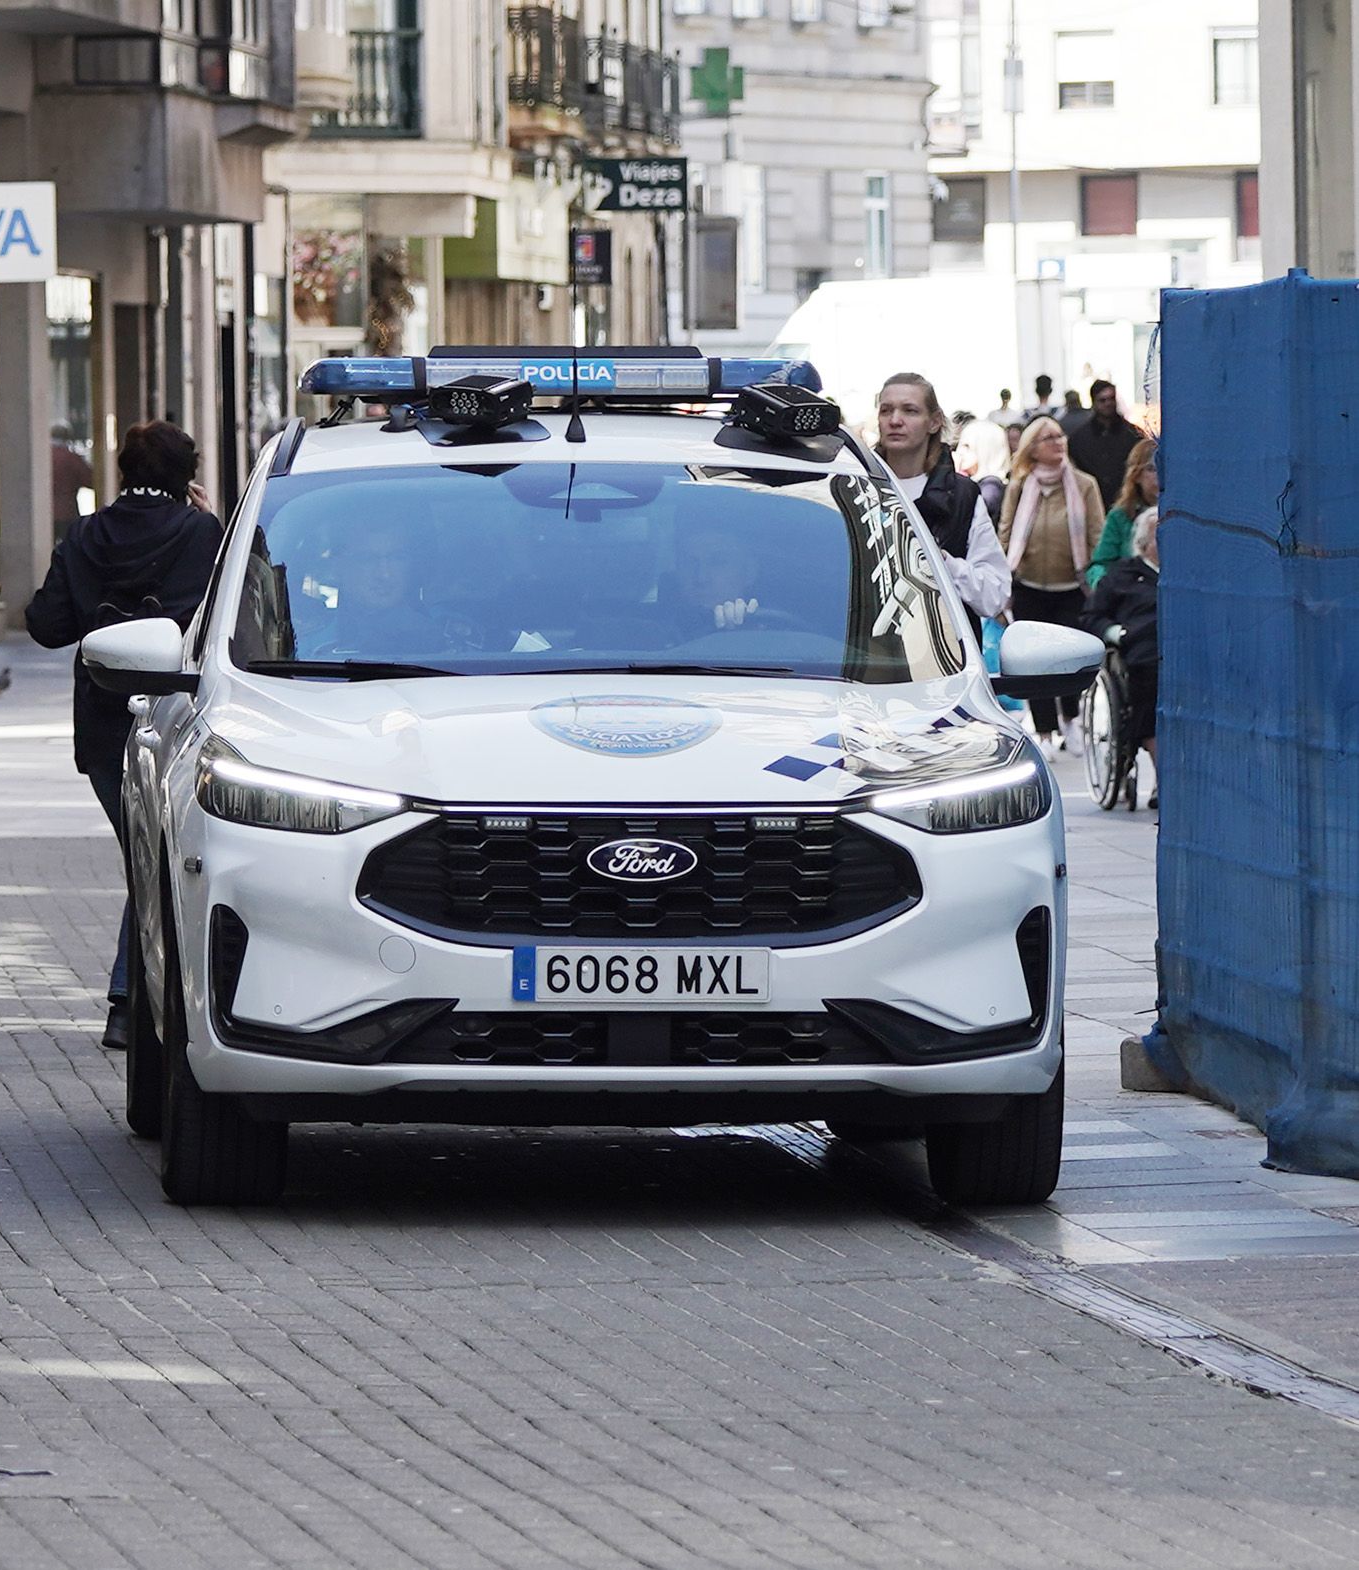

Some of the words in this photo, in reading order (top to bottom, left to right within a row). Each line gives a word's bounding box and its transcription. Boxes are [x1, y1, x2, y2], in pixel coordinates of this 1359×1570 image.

[618, 161, 683, 184] Viajes
[618, 183, 683, 207] Deza
[523, 362, 612, 381] POLICÍA
[608, 845, 676, 873] Ford
[519, 979, 529, 990] E
[546, 954, 659, 994] 6068
[676, 955, 759, 995] MXL
